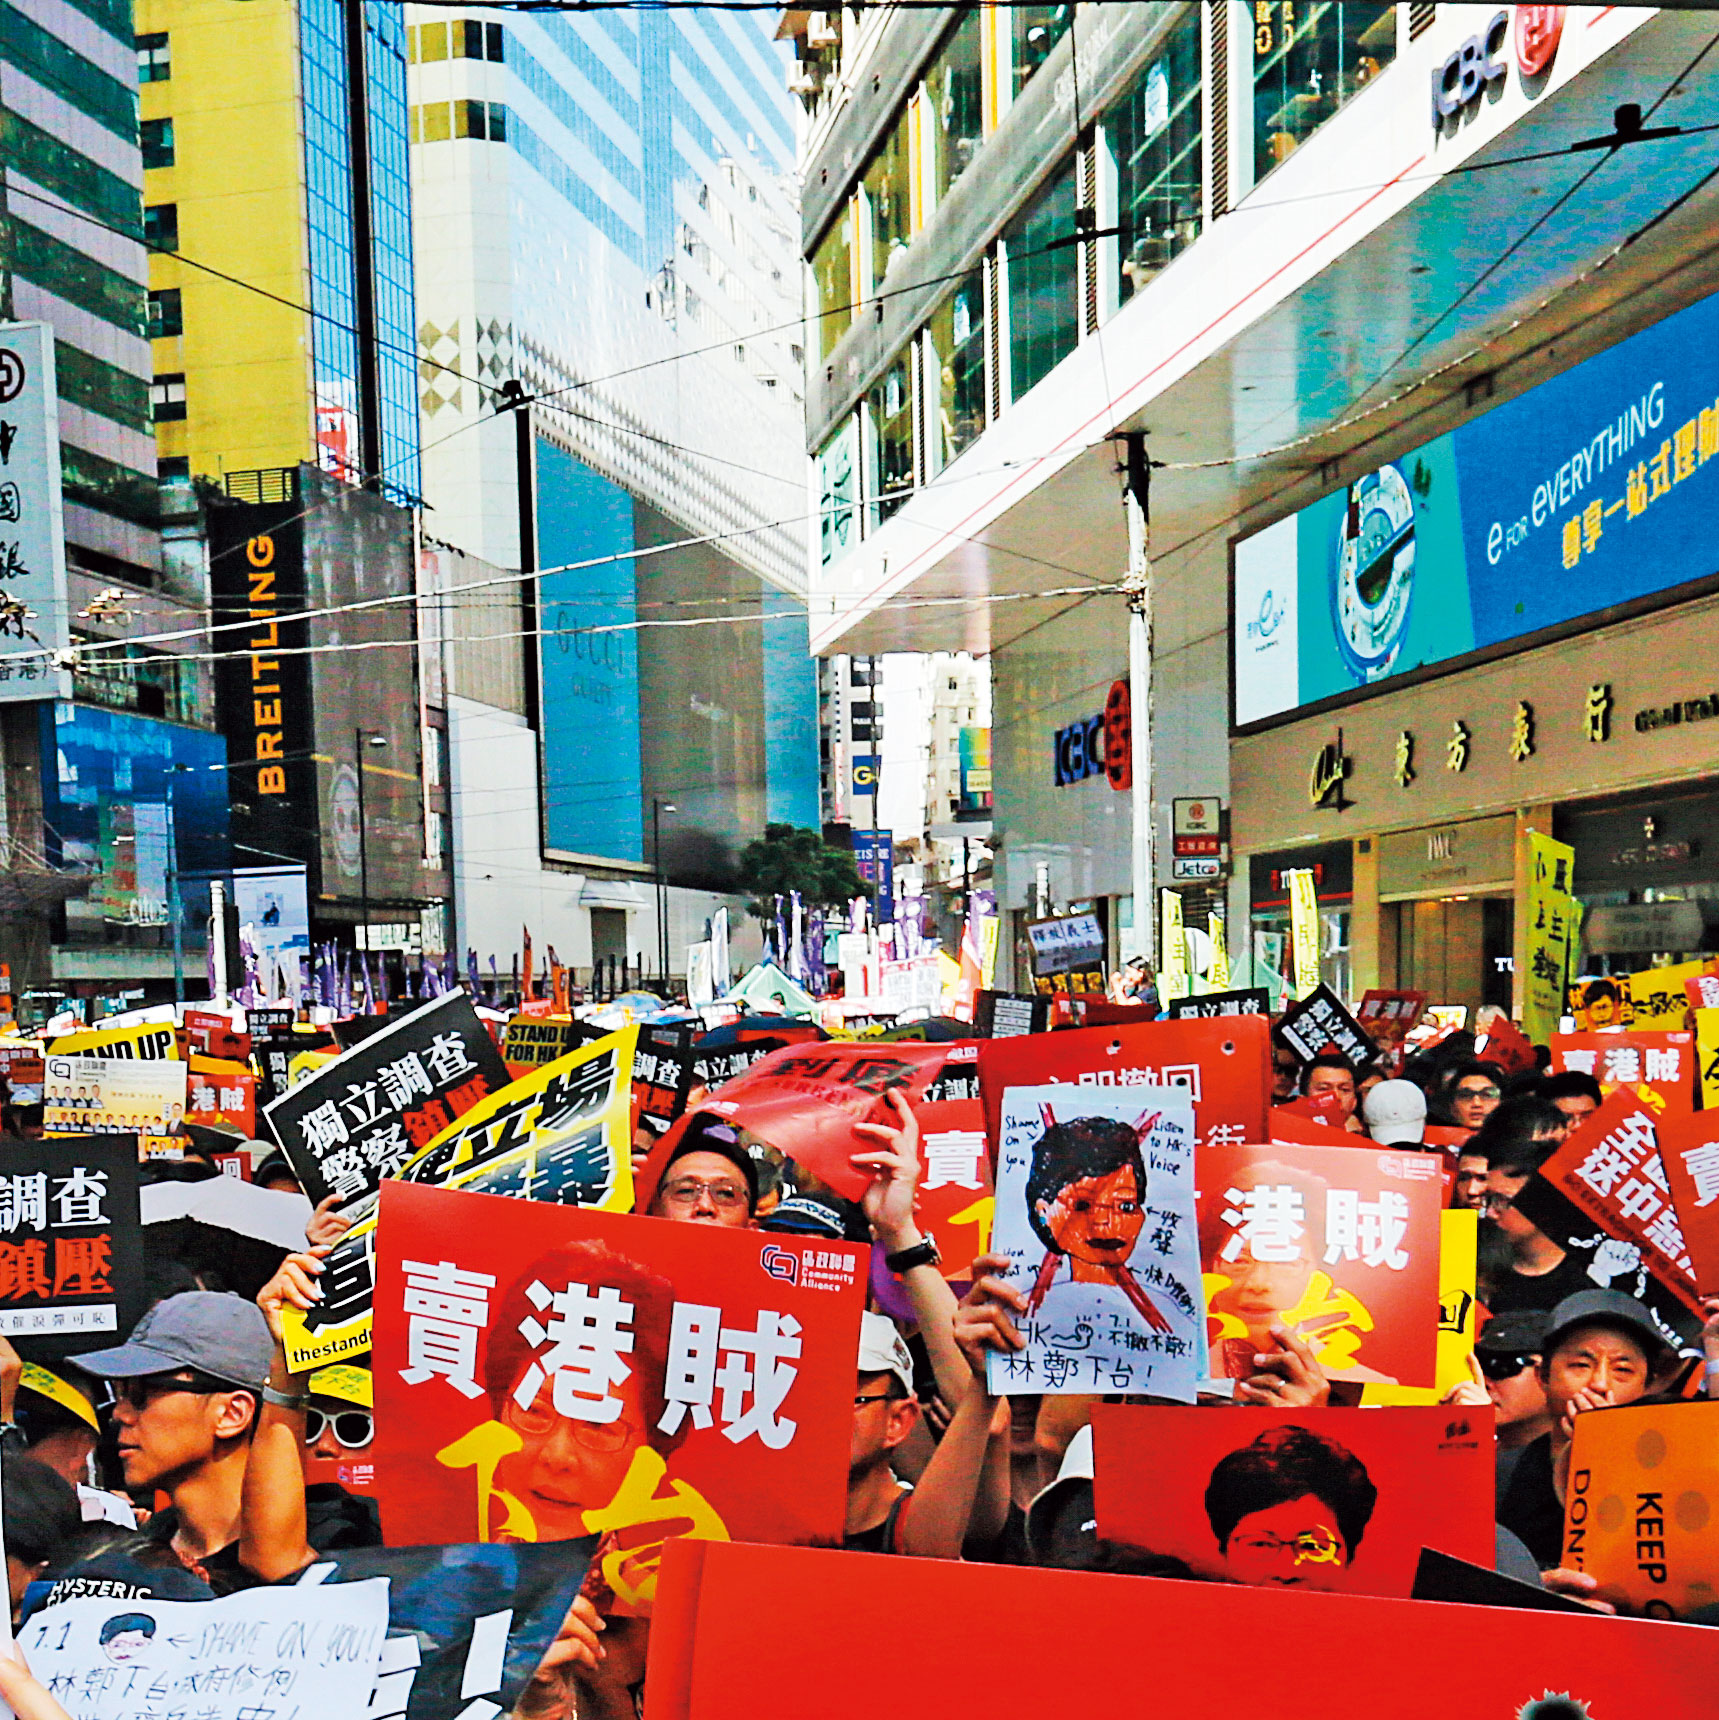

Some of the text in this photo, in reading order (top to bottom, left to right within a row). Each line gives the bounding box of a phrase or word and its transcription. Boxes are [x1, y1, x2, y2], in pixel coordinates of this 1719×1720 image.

[1430, 10, 1510, 138] ICBC
[1486, 382, 1666, 566] e FOR eVERYTHING
[555, 608, 625, 675] GUCCI
[246, 532, 287, 798] BREITLING
[1054, 714, 1106, 787] ICBC
[1176, 860, 1219, 878] Jetco
[136, 1029, 172, 1060] UP
[504, 1044, 562, 1063] FOR HK
[506, 1023, 558, 1046] STAND
[191, 1086, 246, 1112] 港賊
[296, 1030, 479, 1160] 獨立調查
[922, 1130, 988, 1191] 賣
[1149, 1154, 1182, 1177] Voice
[1219, 1183, 1412, 1270] 港賊
[799, 1279, 842, 1293] Alliance
[800, 1268, 855, 1287] Community
[399, 1258, 803, 1451] 賣港賊
[1003, 1350, 1155, 1390] 林鄭下台!
[1635, 1491, 1668, 1585] KEEP
[47, 1576, 153, 1602] HYSTERIC
[276, 1621, 312, 1661] ON
